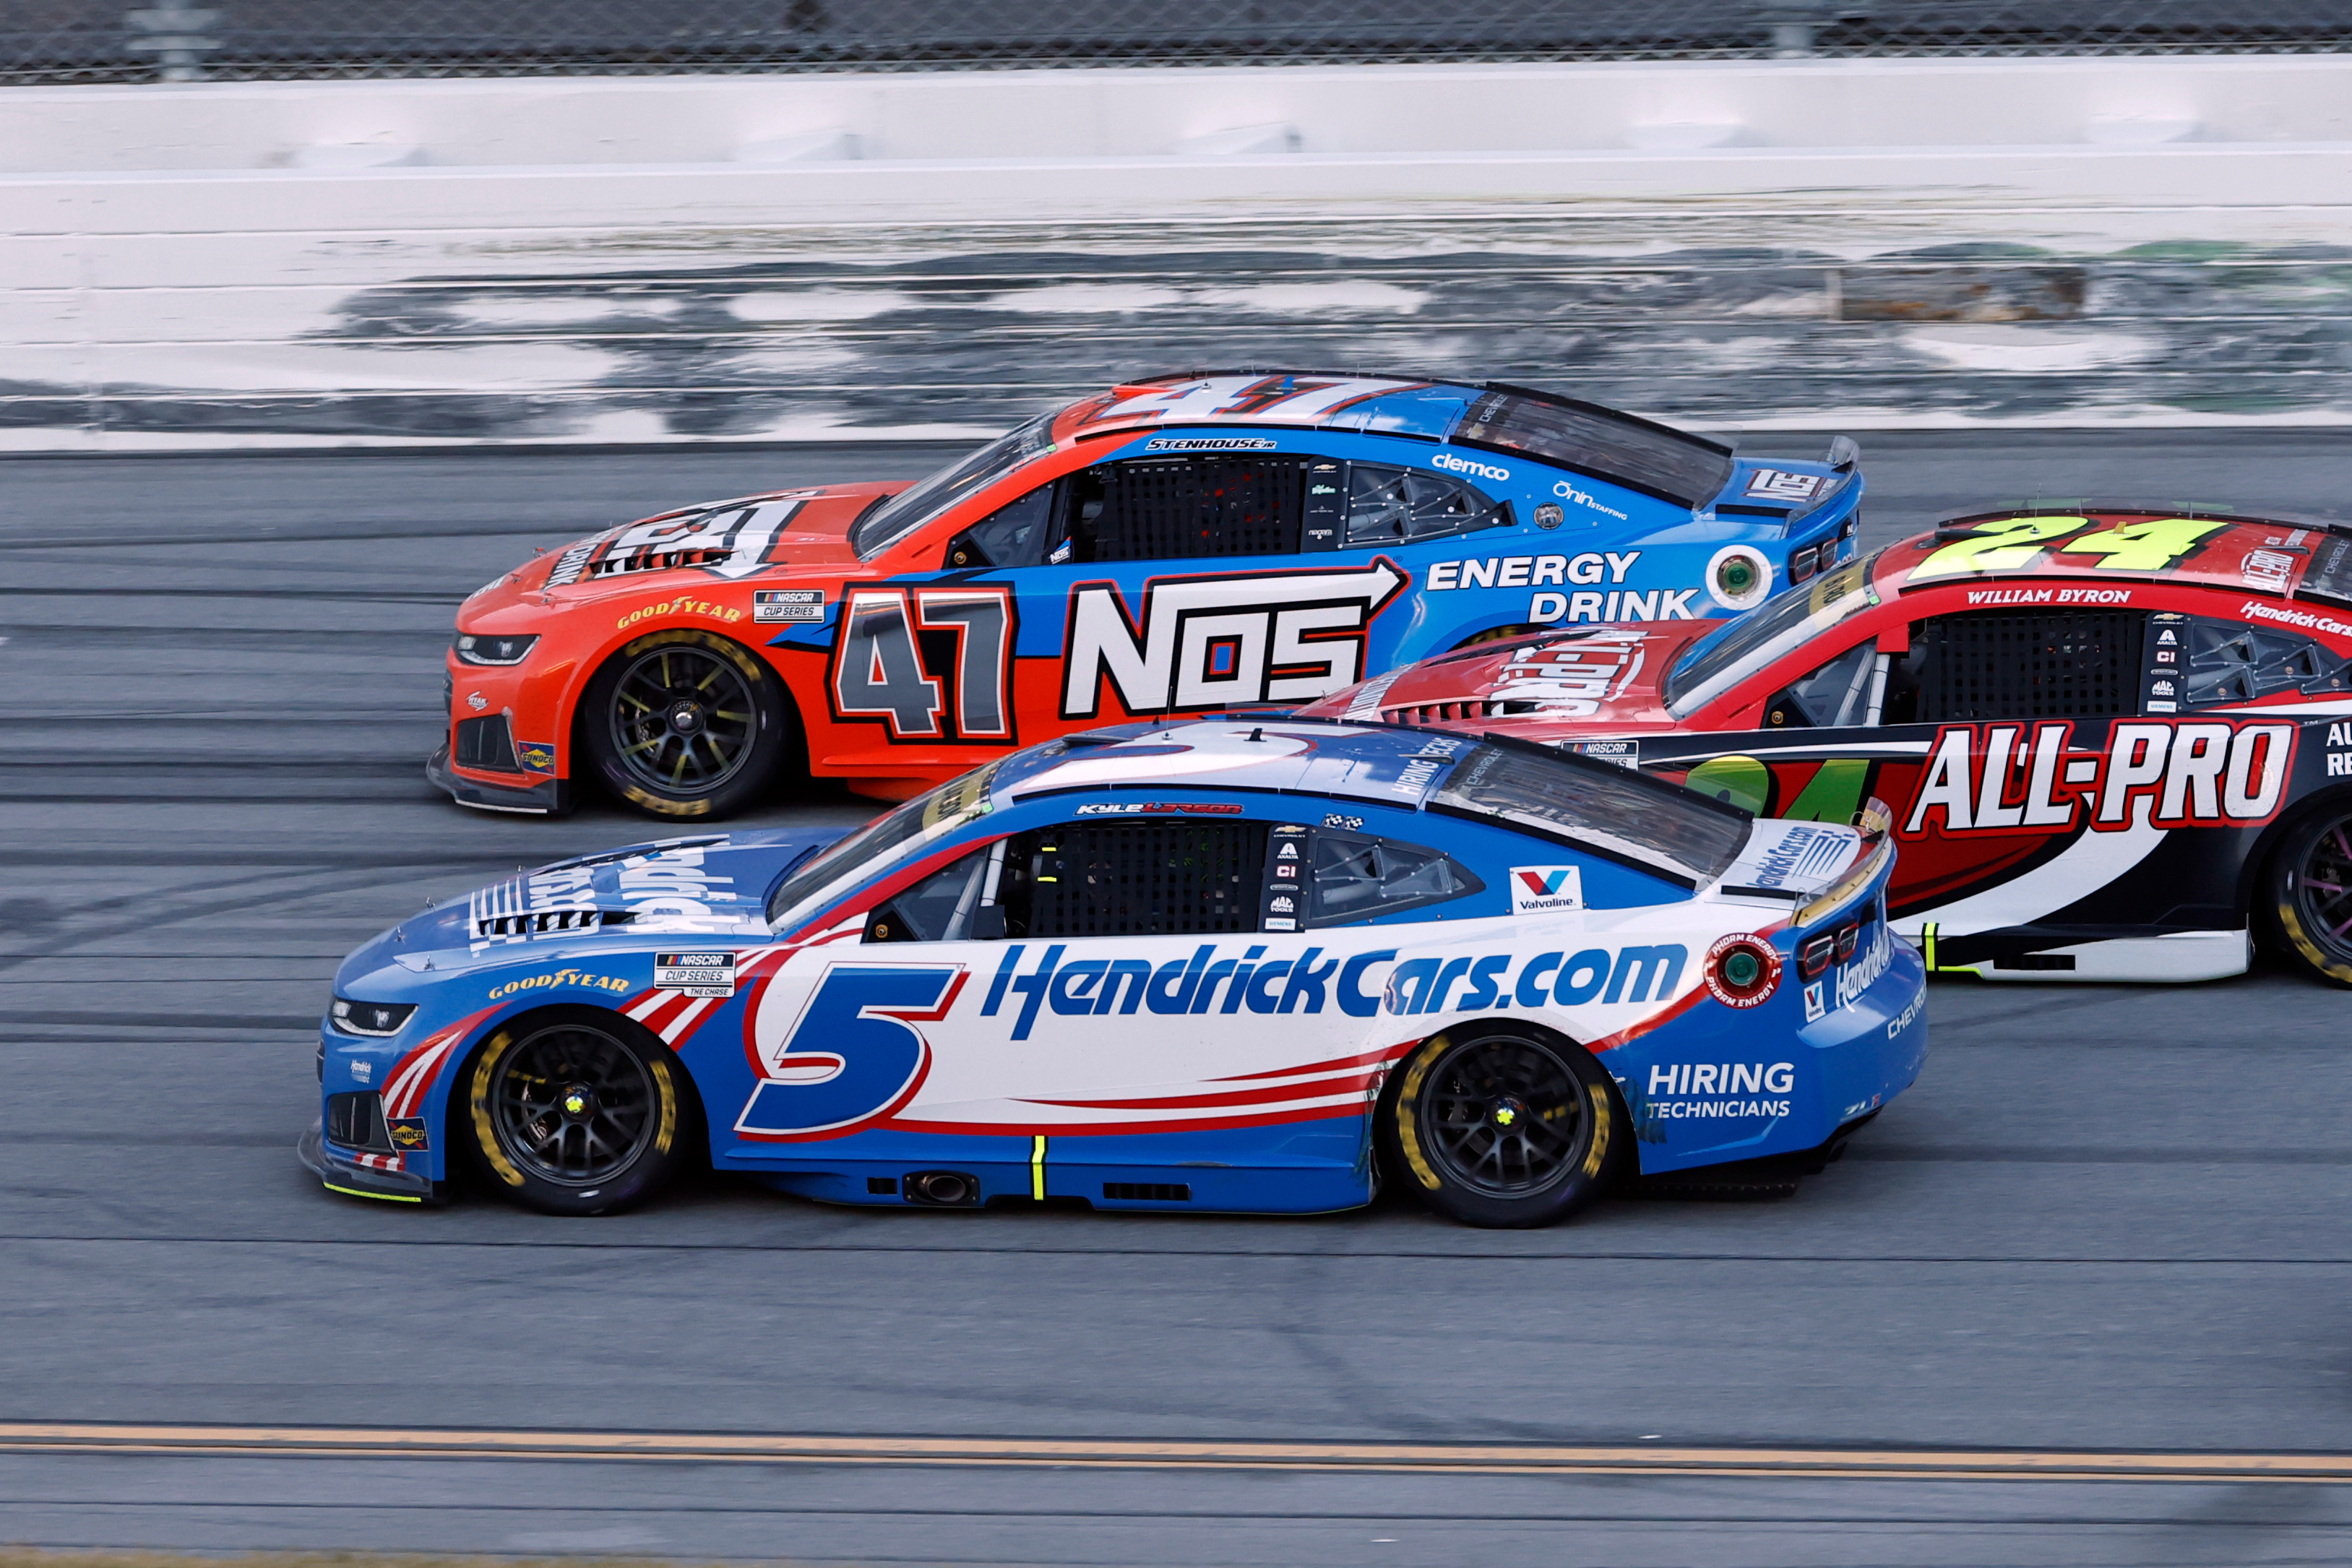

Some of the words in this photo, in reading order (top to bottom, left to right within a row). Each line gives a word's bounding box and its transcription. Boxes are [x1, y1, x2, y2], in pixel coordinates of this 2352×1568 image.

[1091, 374, 1429, 421] 47
[1146, 439, 1265, 450] STENHOUSE
[1431, 454, 1509, 481] clemco
[1590, 501, 1627, 520] STAFFING
[1050, 546, 1069, 562] NOS
[1905, 516, 2229, 581] 24
[543, 543, 591, 591] DRINK
[1426, 551, 1642, 590] ENERGY
[2241, 549, 2294, 591] ALL-PRO
[776, 593, 814, 603] NASCAR
[1529, 588, 1700, 623] DRINK
[1967, 589, 2053, 604] WILLIAM
[2056, 589, 2132, 604] BYRON
[617, 598, 741, 629] GOODYEAR
[764, 607, 783, 616] CUP
[783, 607, 814, 616] SERIES
[1064, 565, 1400, 717] NOS
[835, 591, 1009, 736] 47
[2157, 651, 2175, 662] CI
[2152, 680, 2174, 692] MAC
[522, 754, 554, 764] SUNOCO
[1585, 744, 1627, 754] NASCAR
[1392, 759, 1439, 796] HIRING
[1905, 724, 2291, 831] ALL-PRO
[1074, 803, 1144, 815] KYLE
[1277, 866, 1296, 877] CI
[1270, 896, 1293, 908] MAC
[1520, 898, 1573, 910] Valvoline
[1746, 934, 1778, 960] ENERGY
[680, 955, 724, 965] NASCAR
[488, 970, 630, 1000] GOODYEAR
[665, 971, 686, 981] CUP
[687, 971, 723, 981] SERIES
[980, 944, 1688, 1041] HendrickCars.com
[1738, 981, 1775, 1007] ENERGY
[733, 962, 971, 1142] 5
[1647, 1062, 1795, 1095] HIRING
[1646, 1100, 1791, 1119] TECHNICIANS
[392, 1130, 423, 1140] SUNOCO
